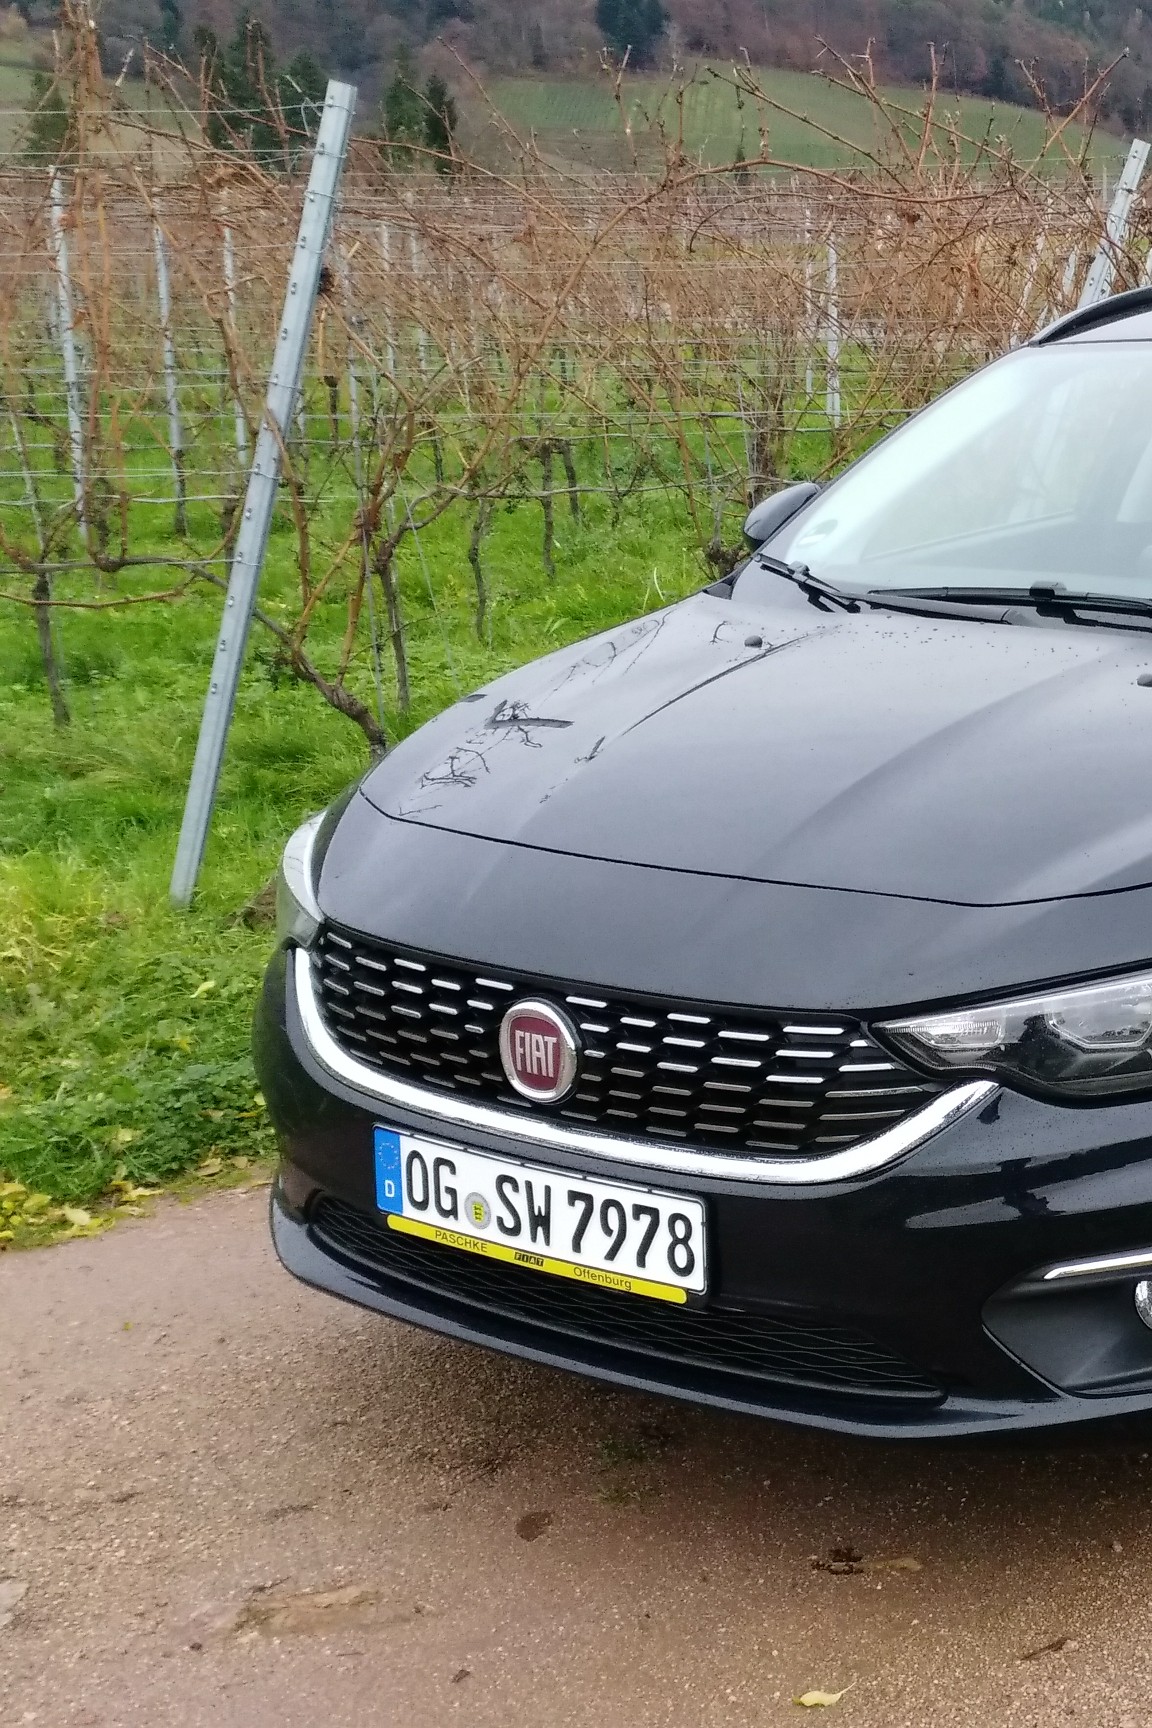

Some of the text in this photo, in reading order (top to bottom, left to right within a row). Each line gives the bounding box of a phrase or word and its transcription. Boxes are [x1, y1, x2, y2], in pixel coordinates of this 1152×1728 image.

[515, 1030, 557, 1078] FIAT
[384, 1179, 395, 1198] D
[405, 1149, 696, 1277] OG SW 7978
[434, 1229, 632, 1291] PASCHKE FIAT Offenburg
